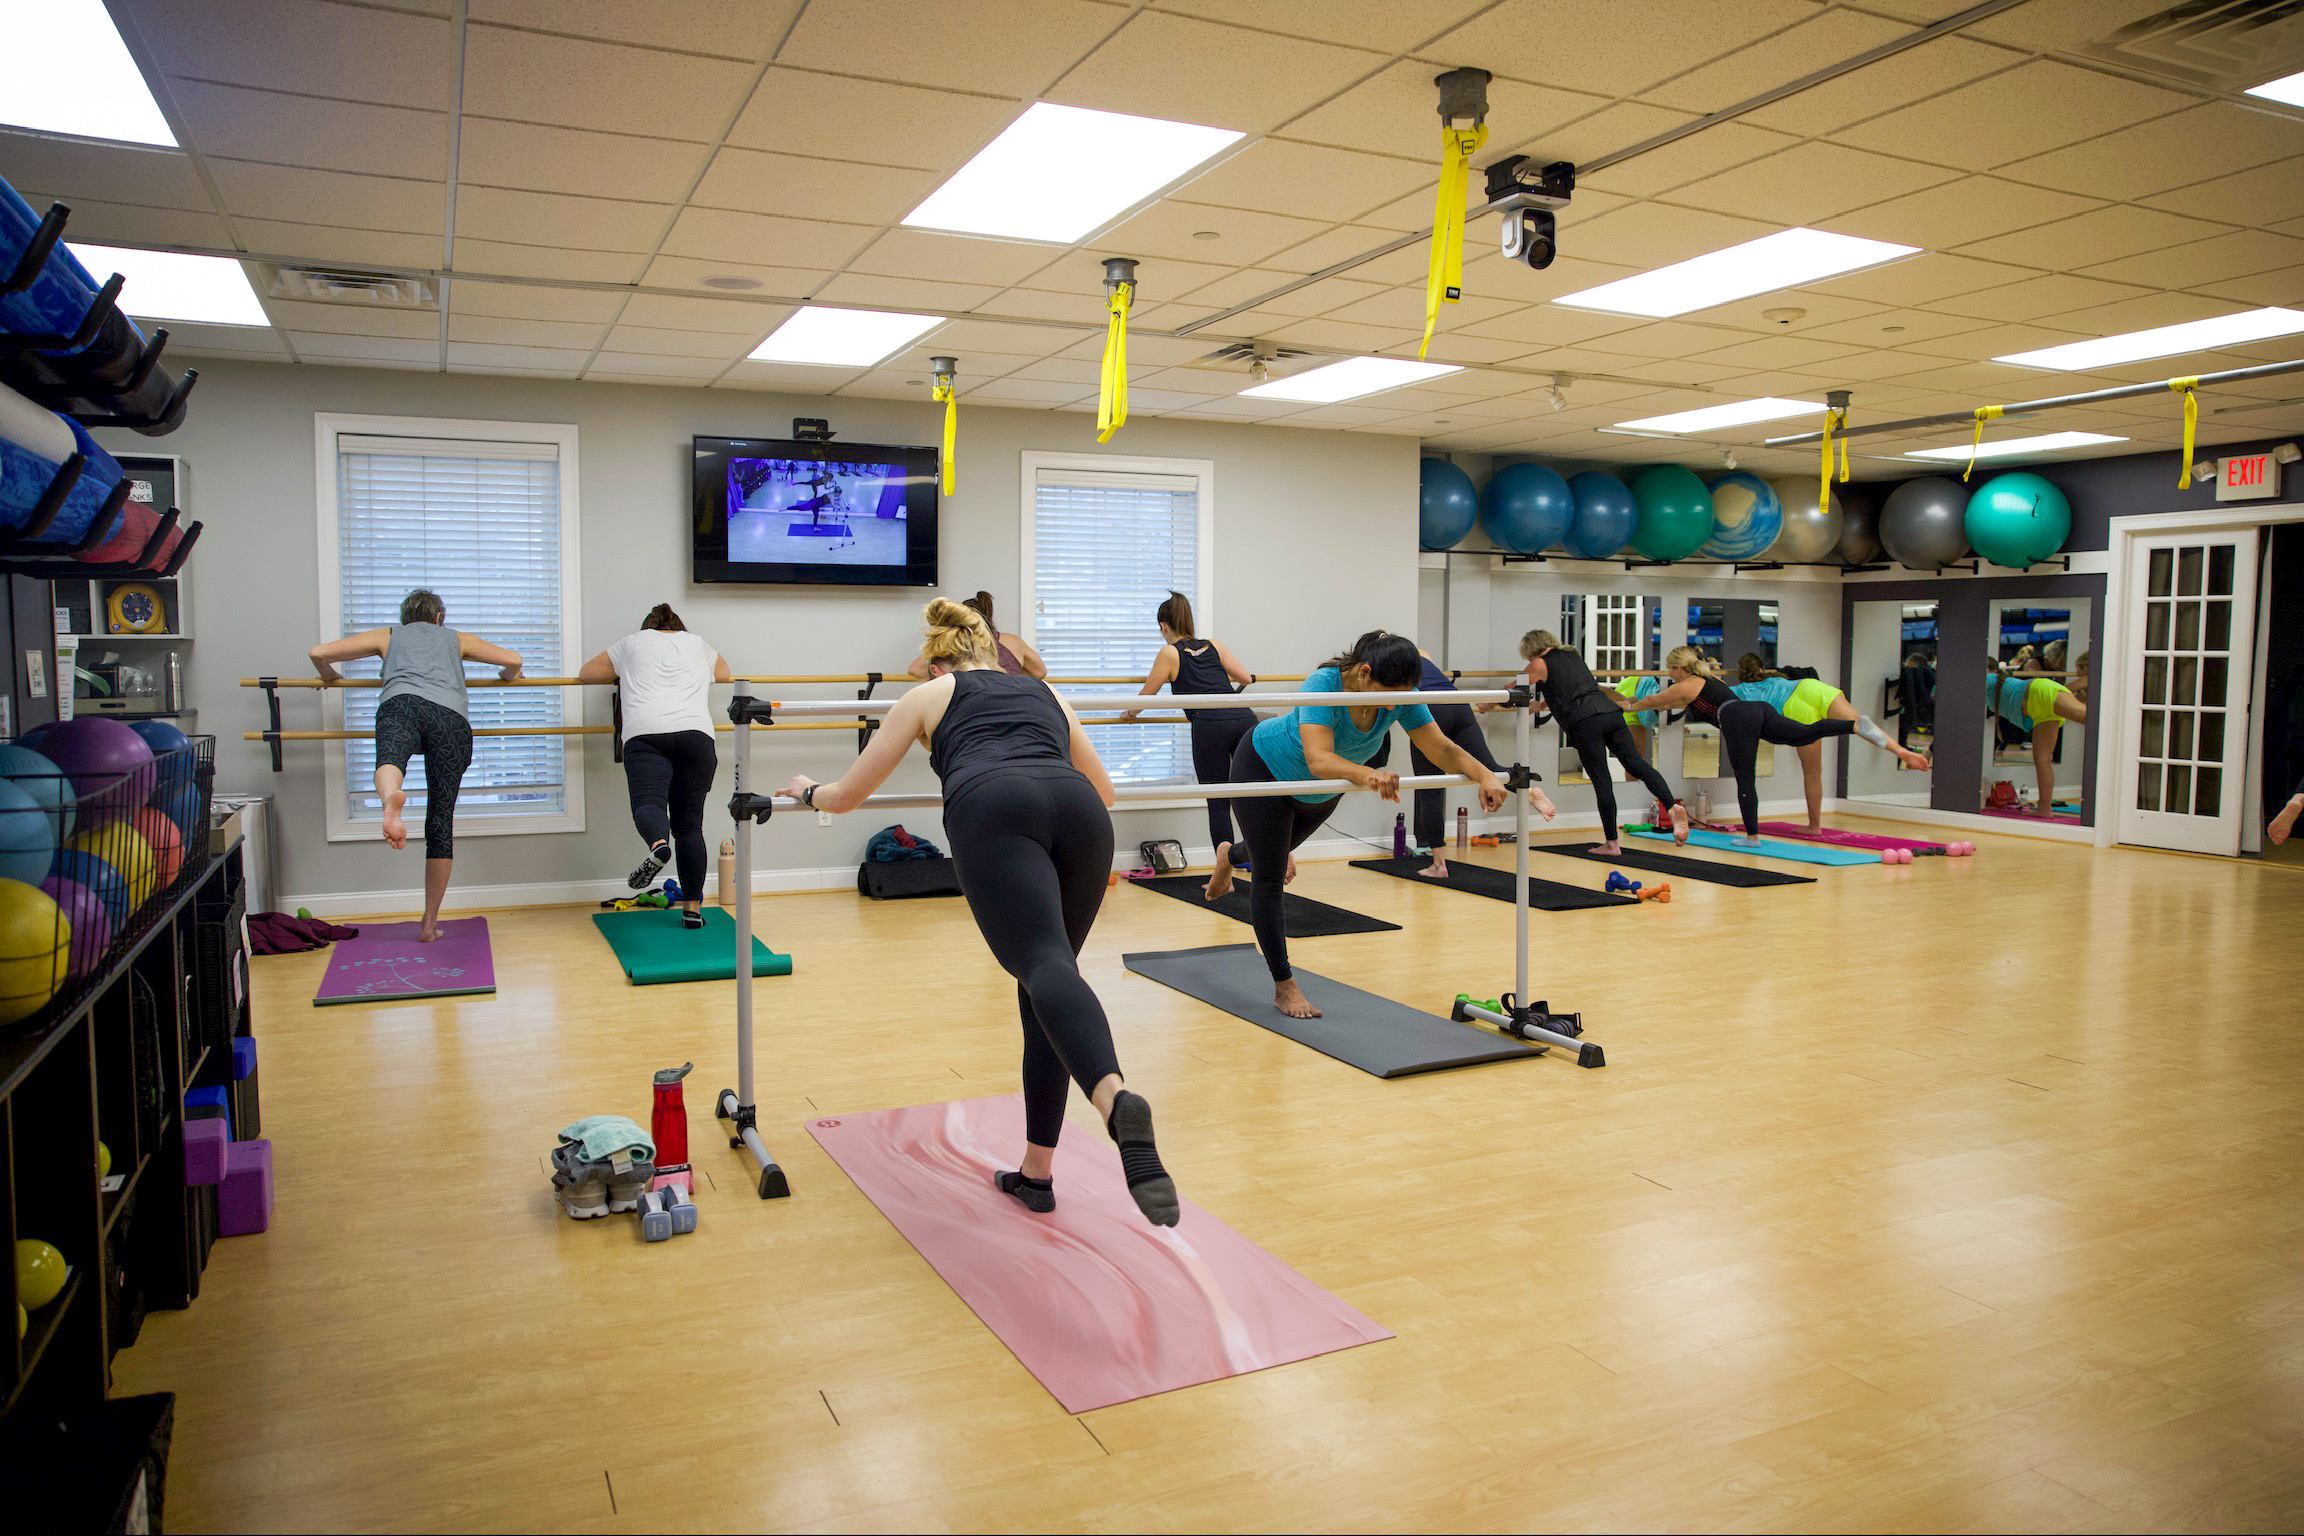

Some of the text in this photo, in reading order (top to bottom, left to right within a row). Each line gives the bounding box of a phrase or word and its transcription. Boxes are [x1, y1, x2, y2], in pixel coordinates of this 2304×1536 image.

[2228, 456, 2266, 486] EXIT
[131, 481, 151, 490] RGE
[128, 493, 153, 501] ANKS
